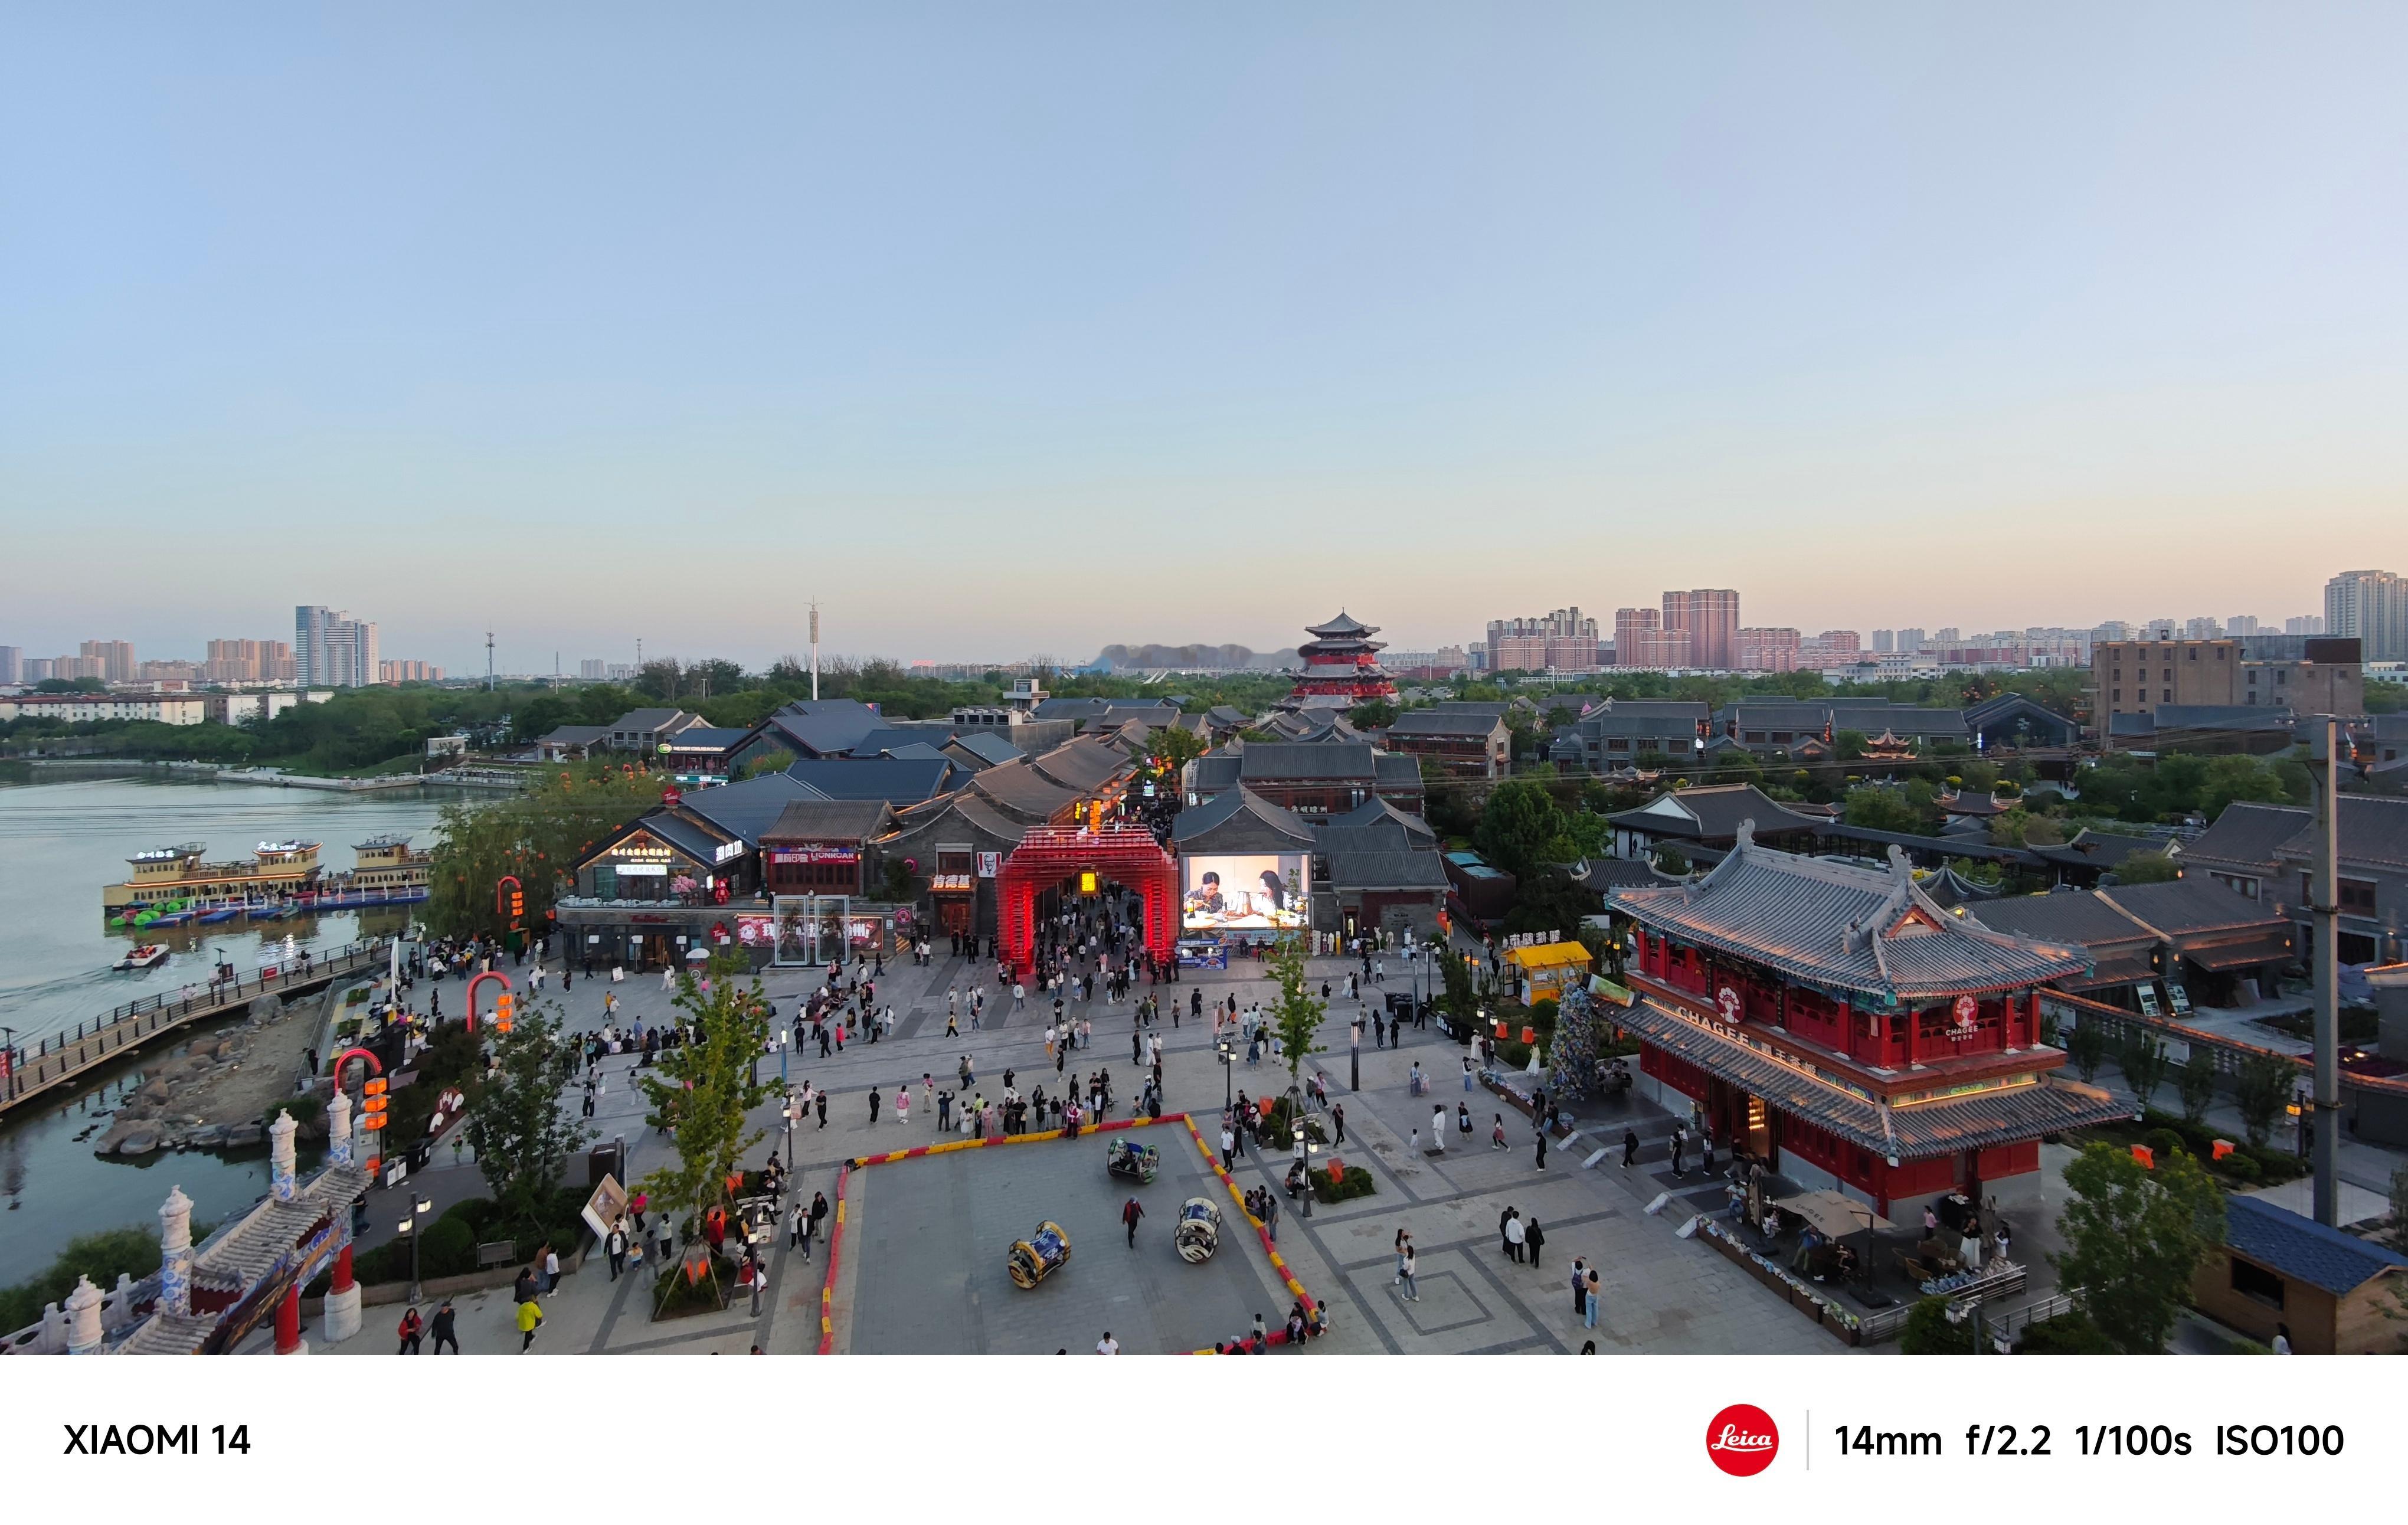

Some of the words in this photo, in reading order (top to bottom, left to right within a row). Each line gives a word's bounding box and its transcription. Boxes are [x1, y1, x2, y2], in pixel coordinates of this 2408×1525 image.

[933, 874, 971, 888] 肯德基
[1677, 1006, 1749, 1046] CHAGEE
[1945, 1025, 1978, 1036] CHAGEE
